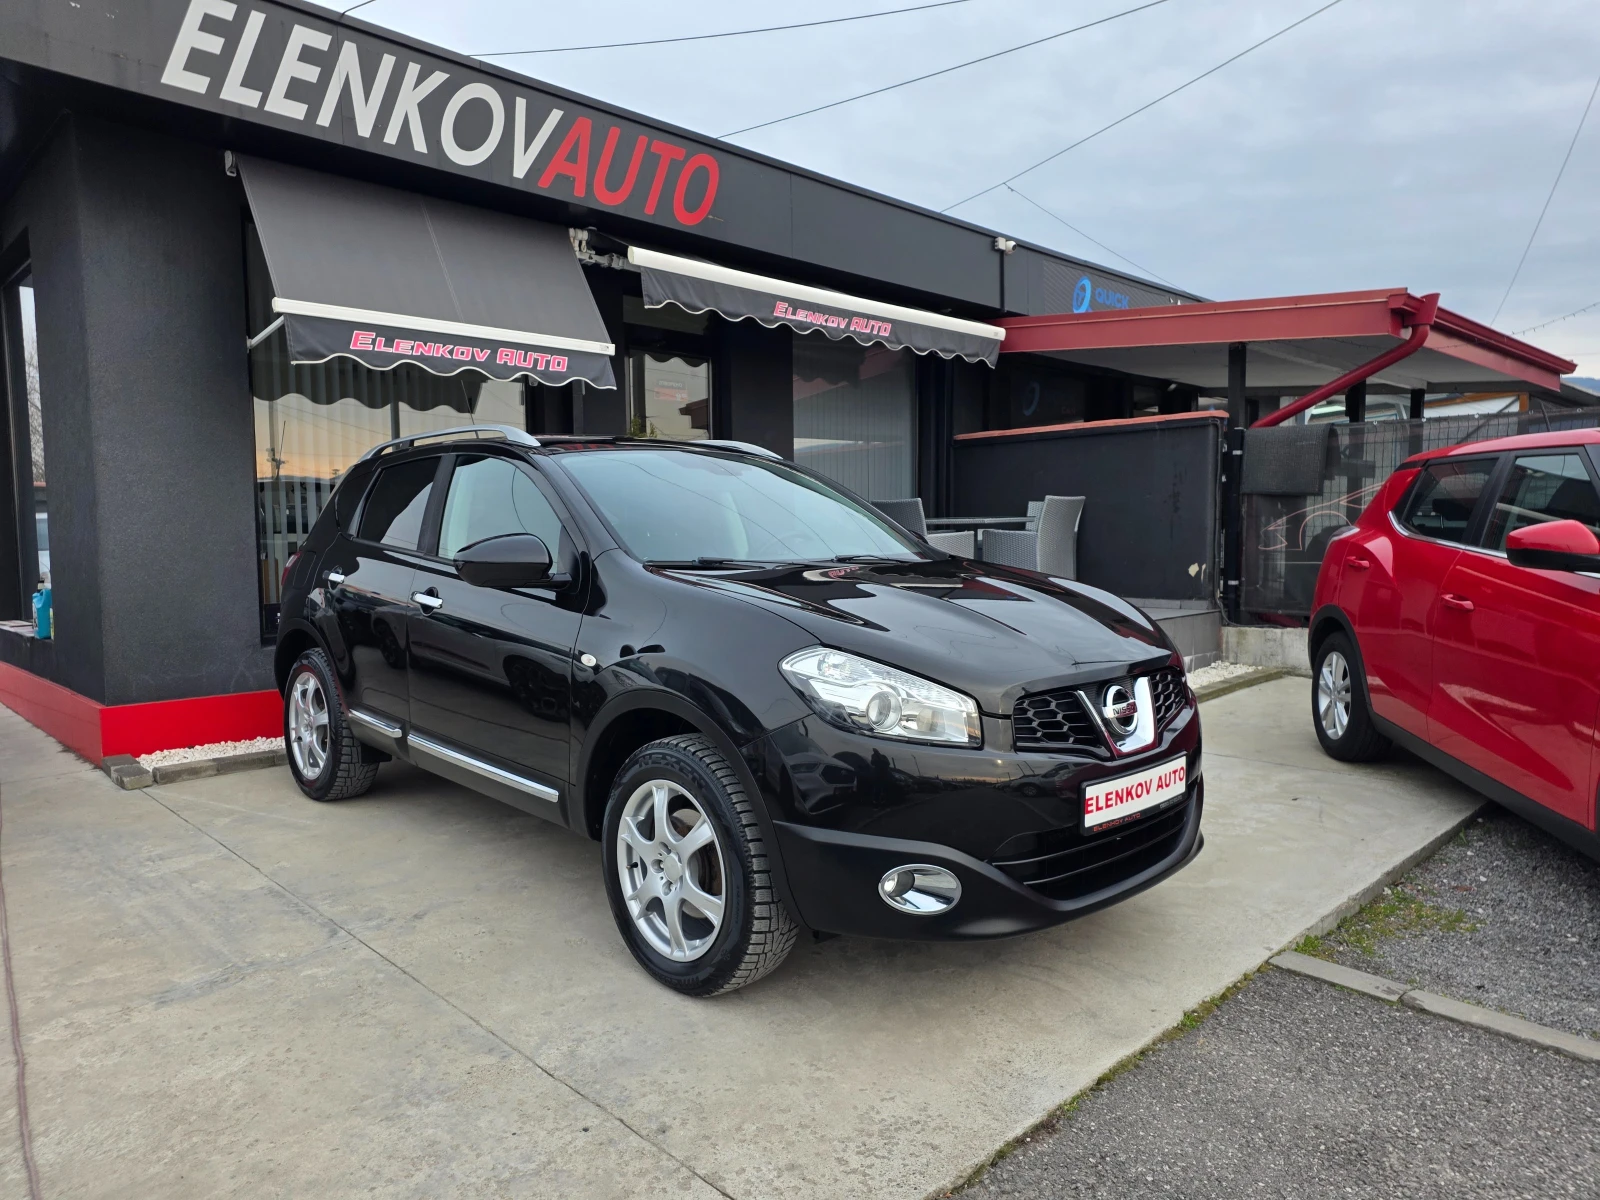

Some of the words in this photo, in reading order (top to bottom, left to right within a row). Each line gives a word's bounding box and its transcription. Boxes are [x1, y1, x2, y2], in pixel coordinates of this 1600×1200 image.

[1095, 288, 1130, 309] QUICK
[773, 301, 849, 328] ELENKOV
[850, 317, 892, 337] AUTO
[350, 330, 491, 361] ELENKOV
[497, 348, 568, 372] AUTO
[638, 754, 706, 787] NEXEN
[1084, 780, 1152, 815] ELENKOV
[1156, 766, 1185, 792] AUTO
